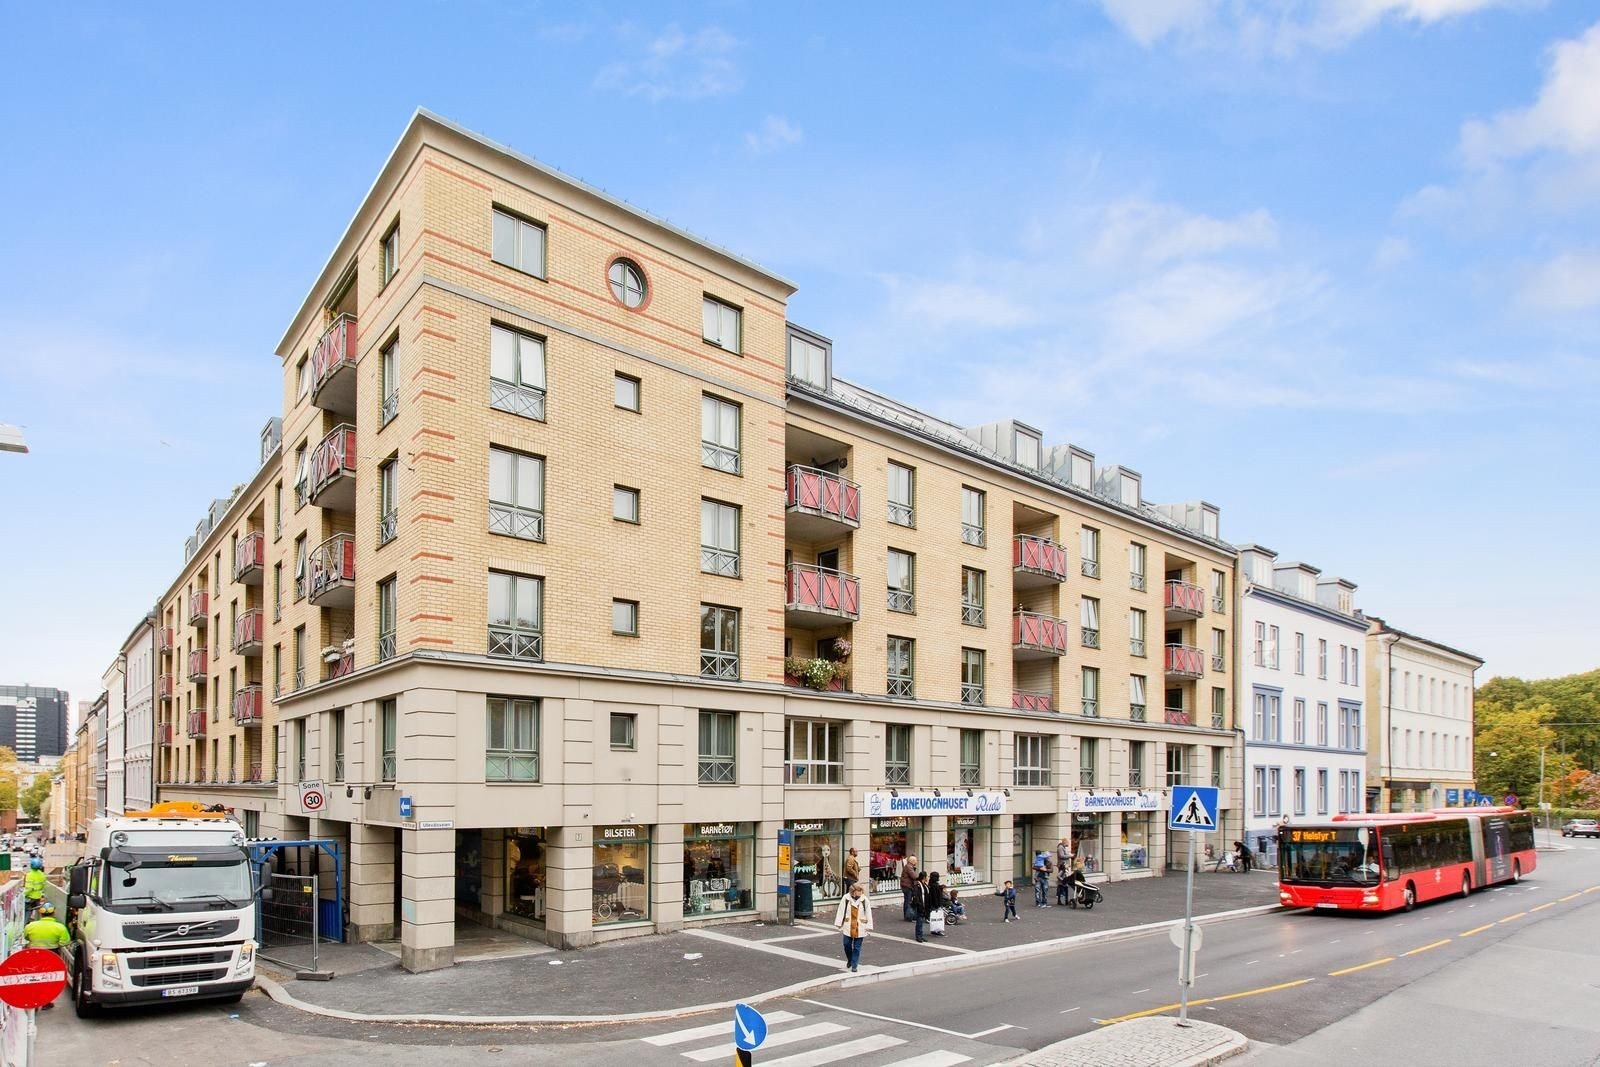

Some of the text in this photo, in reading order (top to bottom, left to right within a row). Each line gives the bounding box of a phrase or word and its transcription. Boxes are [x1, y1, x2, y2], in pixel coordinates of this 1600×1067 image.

[306, 795, 320, 806] 30
[891, 797, 968, 810] BARNEVOGNHUSET
[1085, 797, 1136, 807] BARNEVOGNHUSET
[604, 828, 636, 838] BILSETER
[701, 824, 734, 835] BARNETØY
[1292, 831, 1301, 841] 37
[1330, 831, 1337, 841] T
